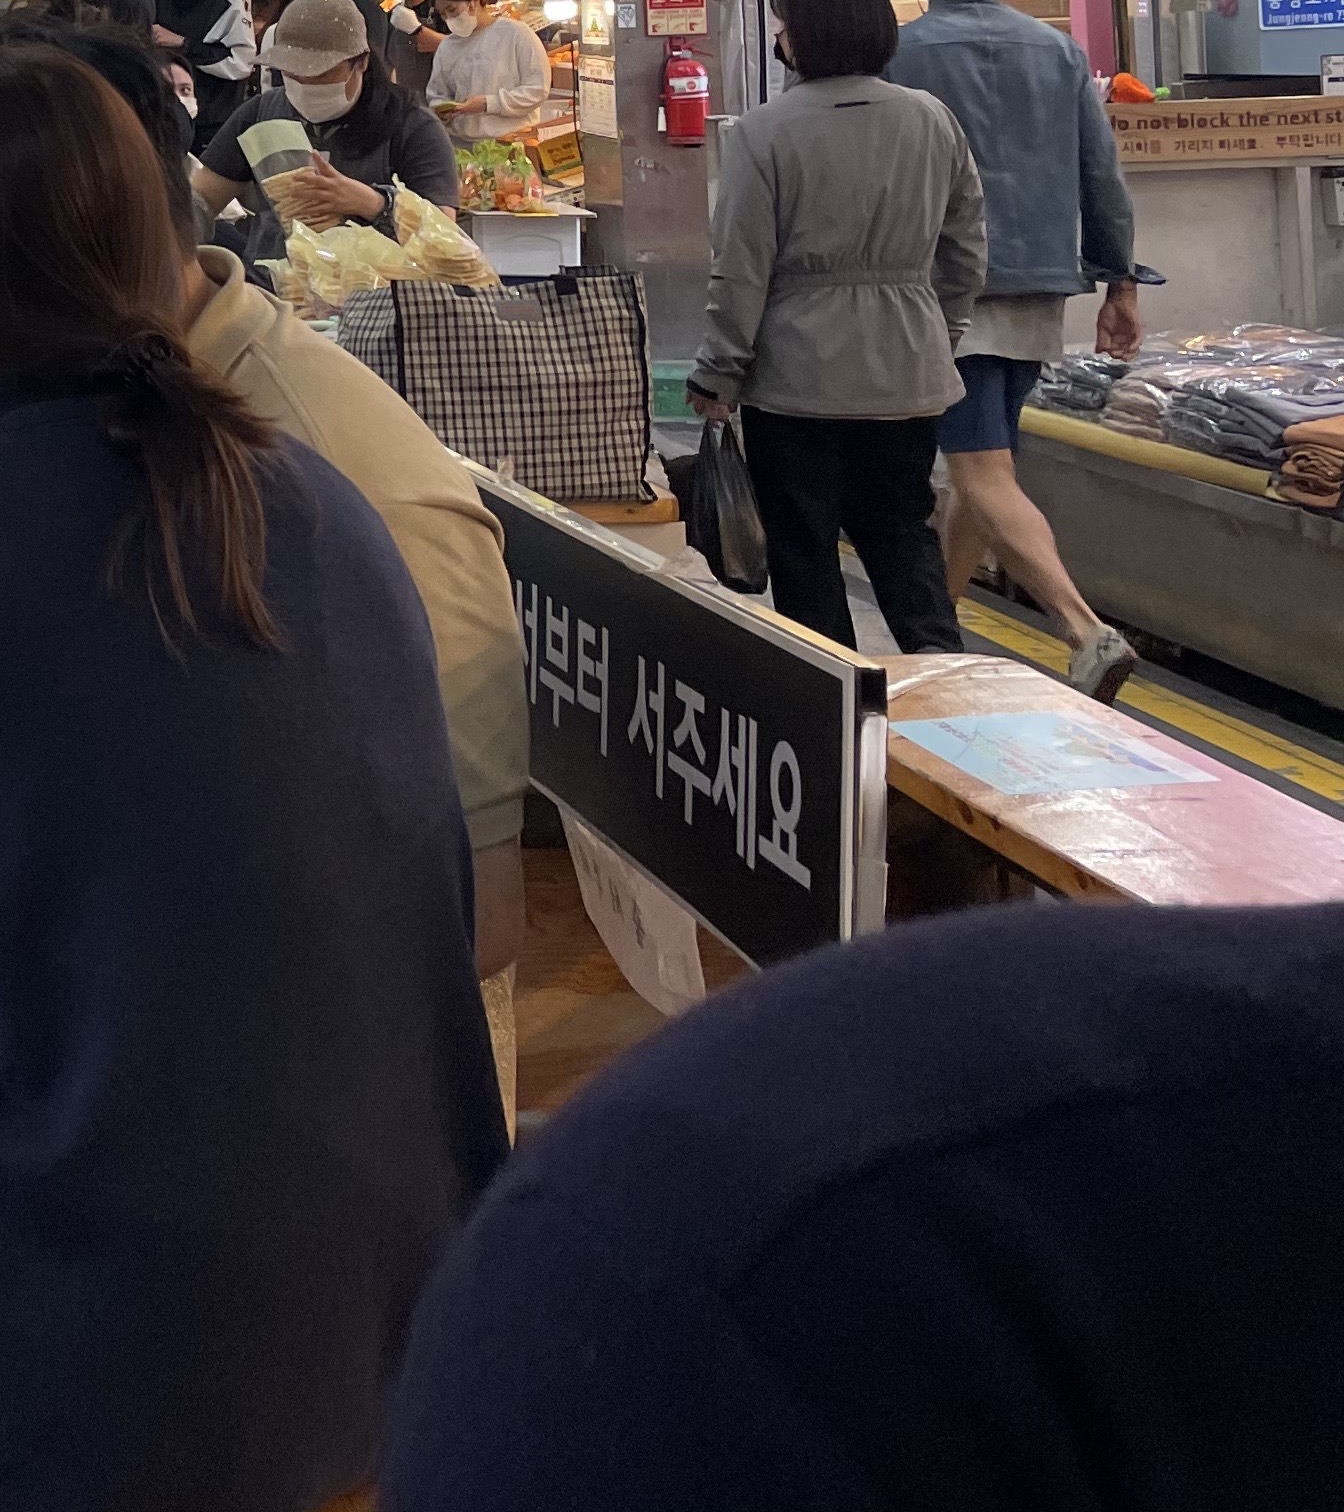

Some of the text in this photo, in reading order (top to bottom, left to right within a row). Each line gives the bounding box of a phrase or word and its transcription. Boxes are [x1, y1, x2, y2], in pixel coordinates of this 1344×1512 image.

[1267, 11, 1335, 27] Jungjeong-ro
[1136, 115, 1170, 131] not
[1176, 112, 1230, 129] block
[1239, 111, 1271, 128] the
[1277, 110, 1320, 127] next
[626, 654, 812, 892] 서주세요
